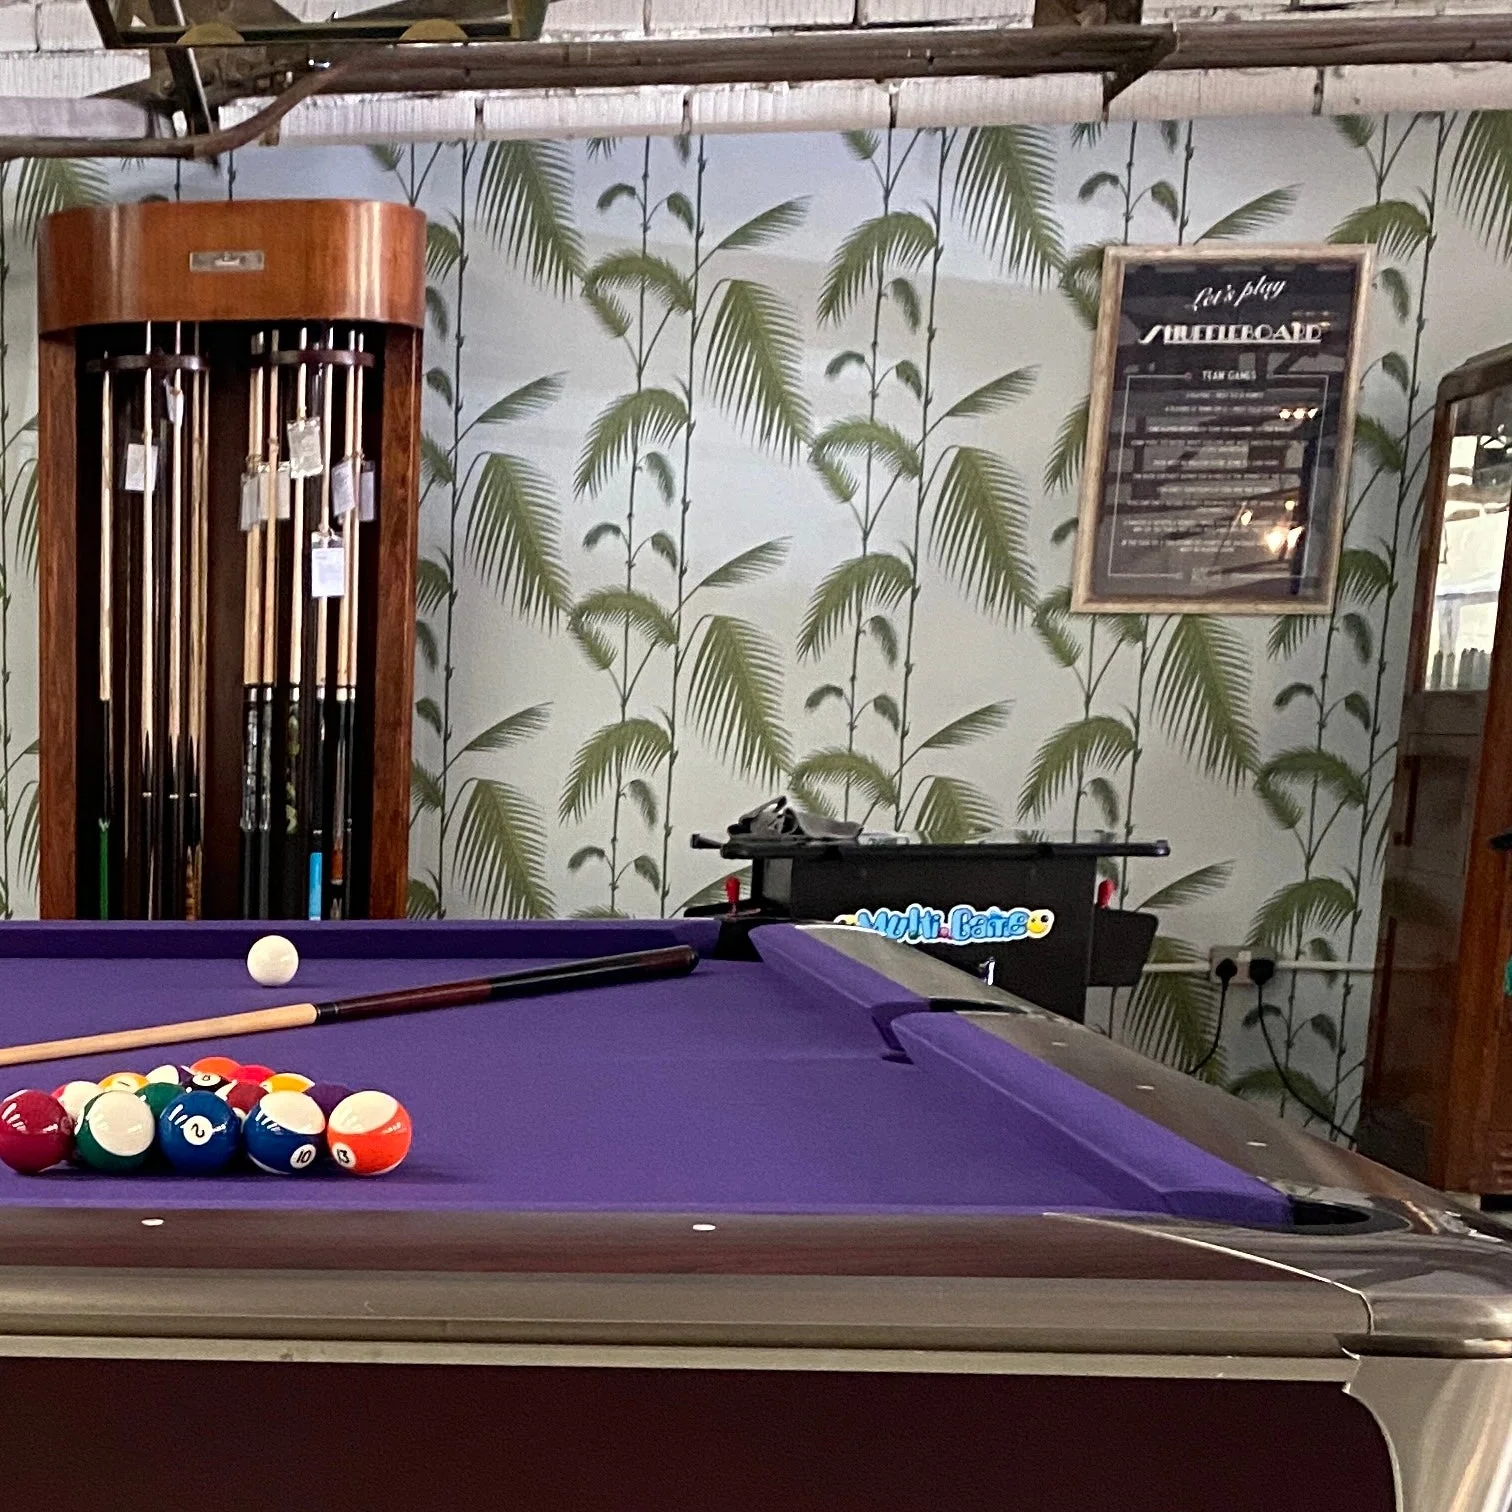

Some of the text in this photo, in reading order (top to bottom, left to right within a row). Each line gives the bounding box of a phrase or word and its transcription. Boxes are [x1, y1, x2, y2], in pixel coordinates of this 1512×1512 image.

[1192, 275, 1287, 311] Let's play
[1138, 322, 1322, 345] SHUFFLEBOARD
[1202, 369, 1257, 381] TEAM GAMES
[950, 906, 1029, 942] Game
[190, 1122, 206, 1138] 2
[296, 1149, 311, 1164] 10
[336, 1148, 350, 1163] 13
